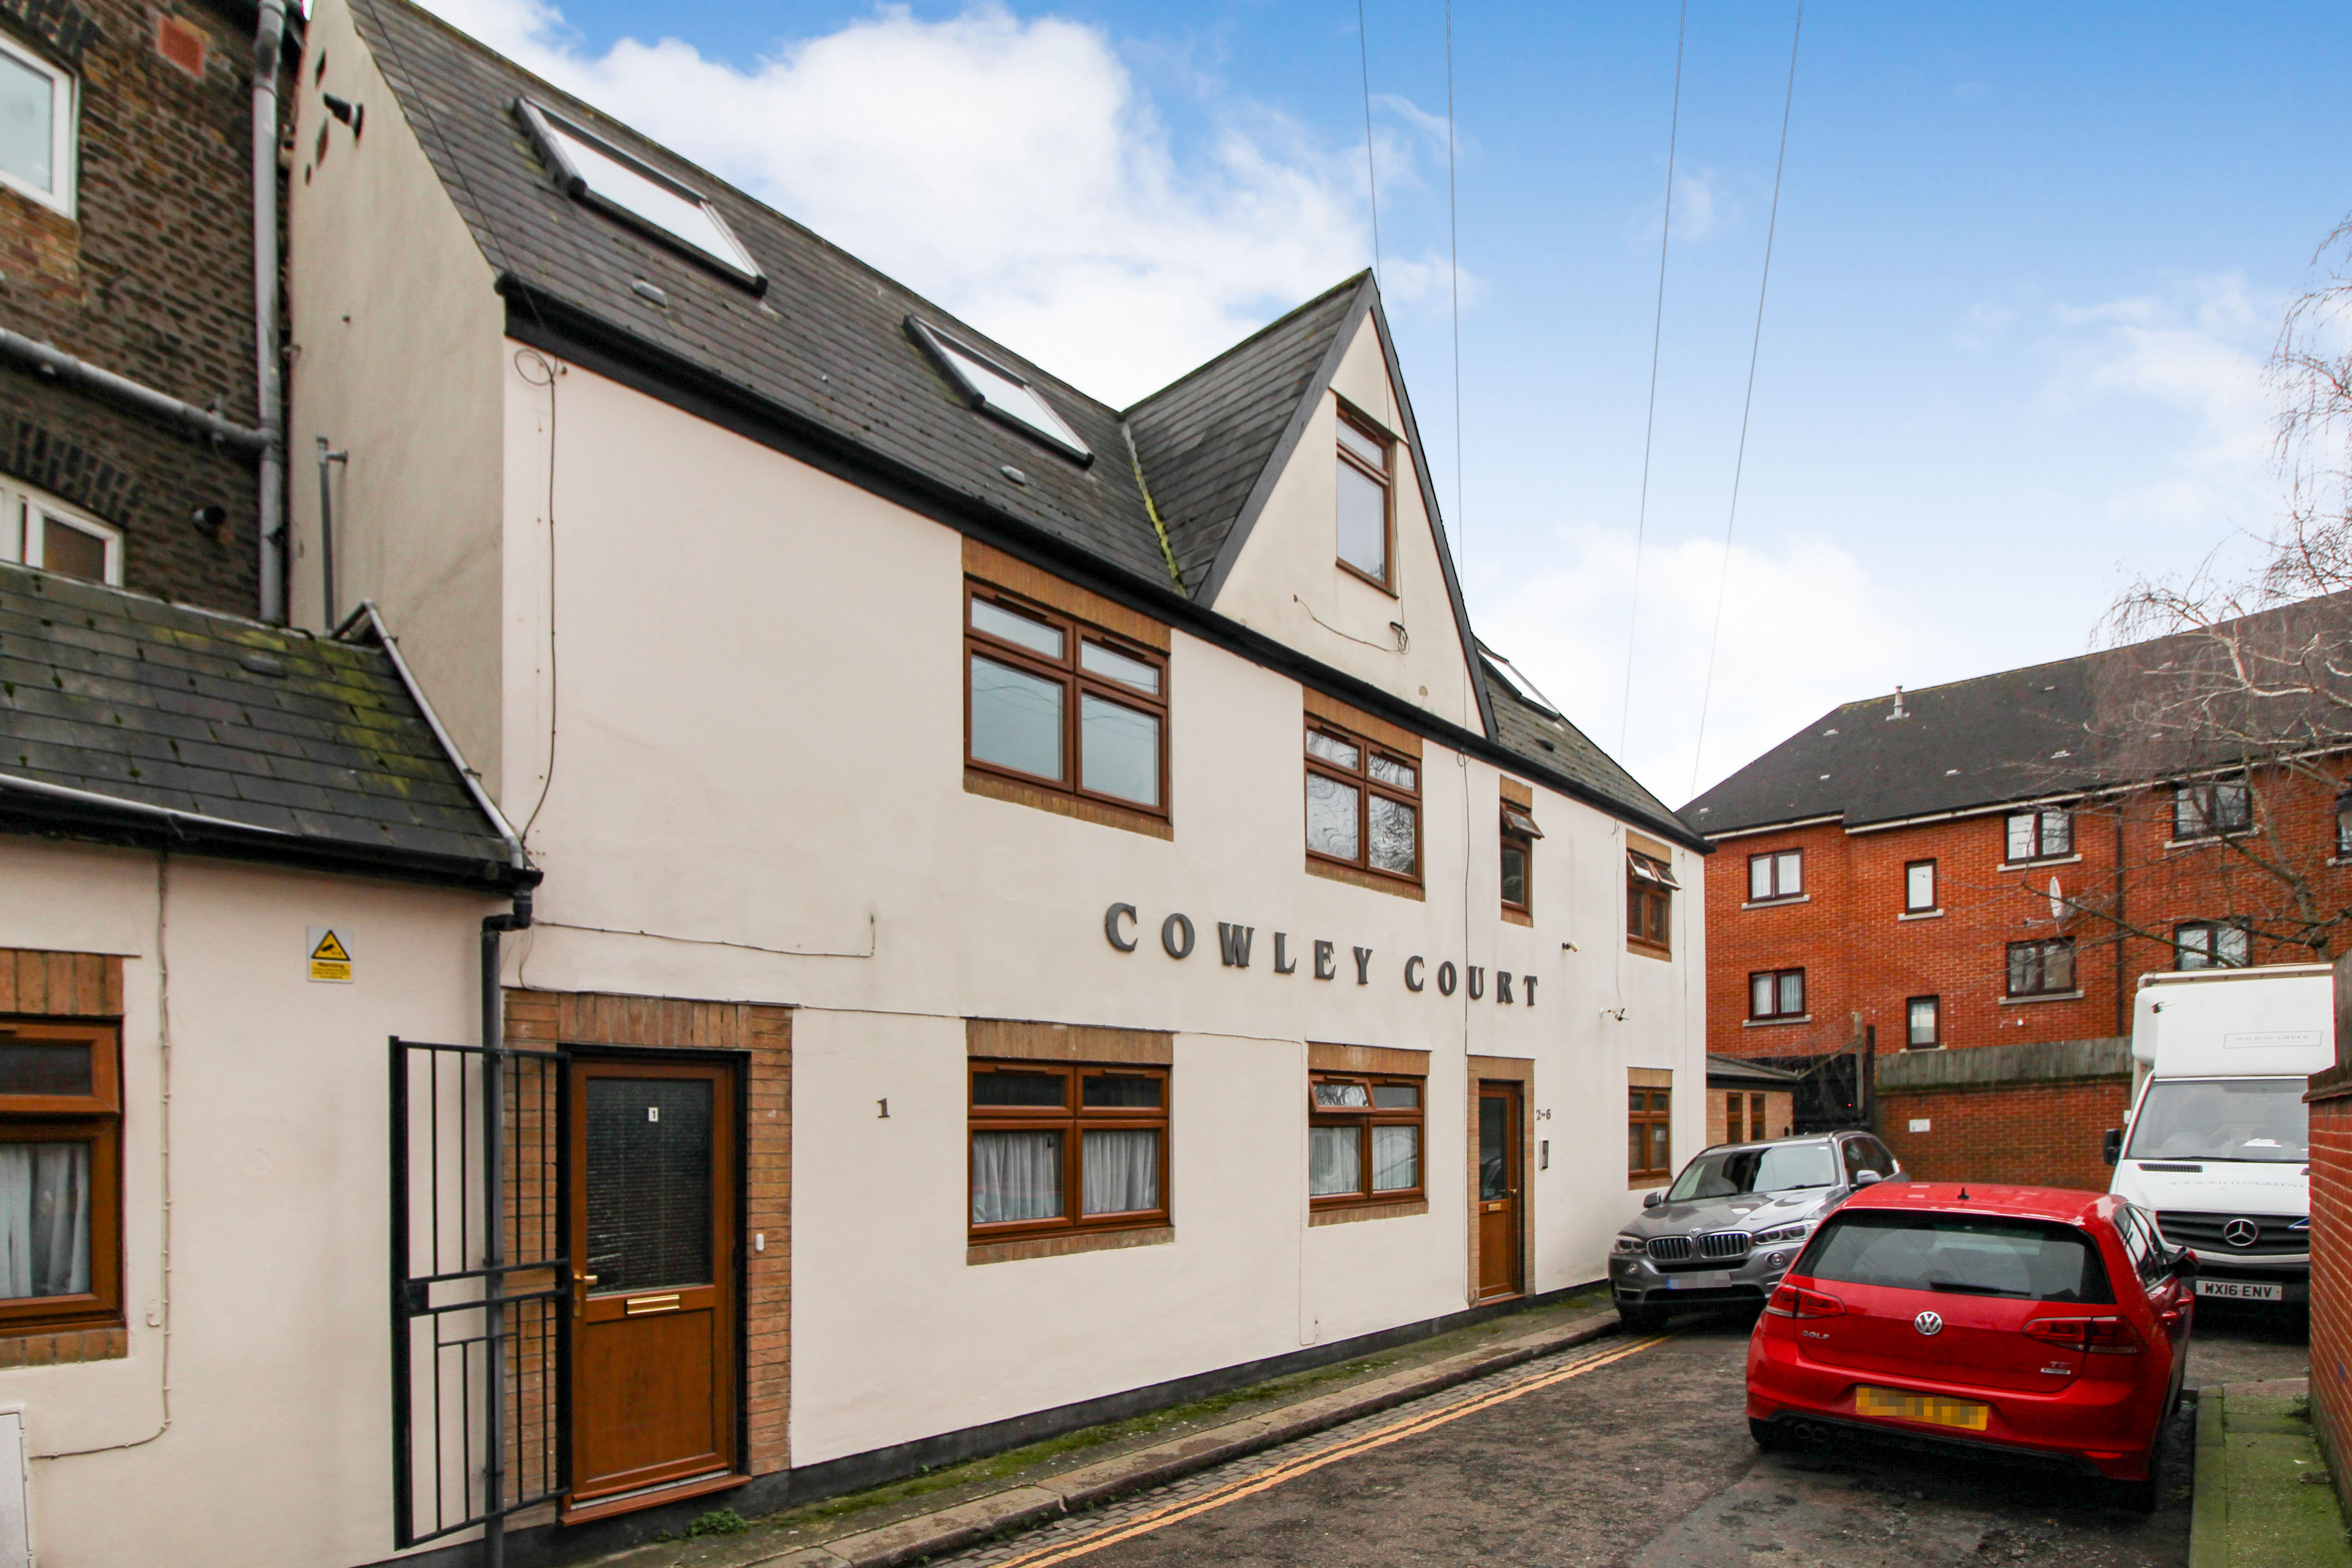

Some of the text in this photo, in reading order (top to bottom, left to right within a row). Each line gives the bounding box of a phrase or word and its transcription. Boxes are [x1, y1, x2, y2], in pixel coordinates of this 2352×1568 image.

[1105, 902, 1538, 1006] COWLEY COURT
[877, 1098, 890, 1118] 1
[1536, 1108, 1551, 1121] 2-6
[2205, 1283, 2272, 1298] WX16 ENV
[1802, 1330, 1829, 1339] GOLF
